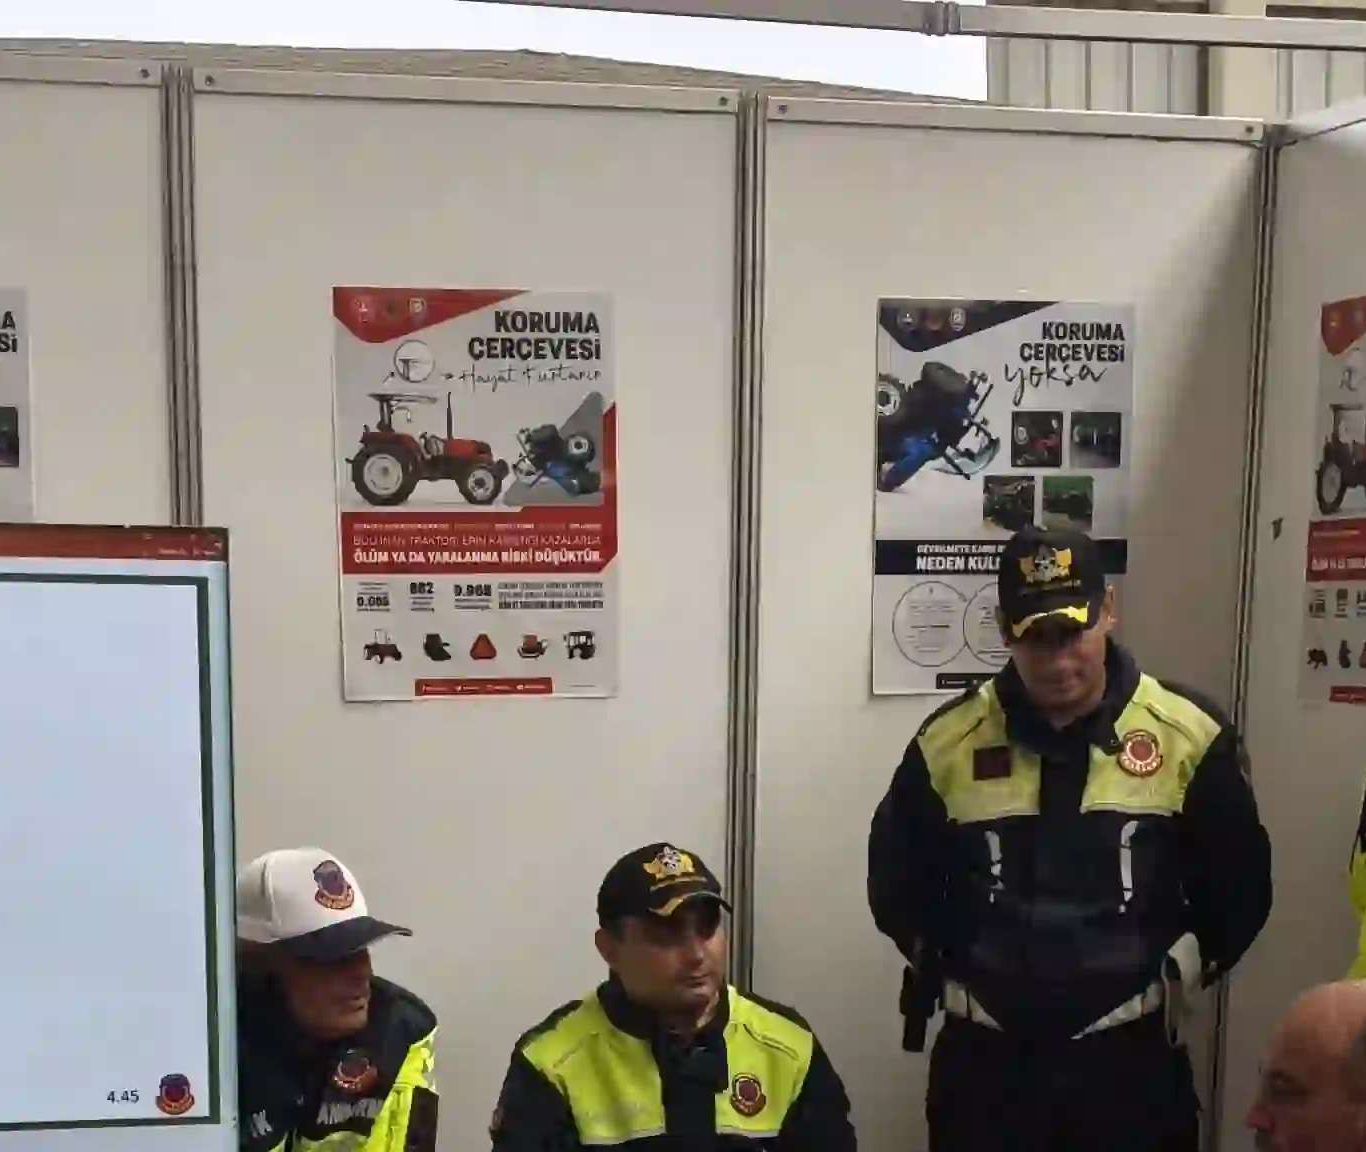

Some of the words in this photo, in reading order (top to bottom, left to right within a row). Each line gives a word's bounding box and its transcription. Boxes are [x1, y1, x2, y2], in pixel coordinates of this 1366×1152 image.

[494, 310, 600, 333] KORUMA
[1042, 322, 1125, 341] KORUMA
[1005, 360, 1108, 406] yoksa
[392, 551, 407, 563] YA
[916, 556, 965, 570] NEDEN
[107, 1089, 140, 1104] 4.45
